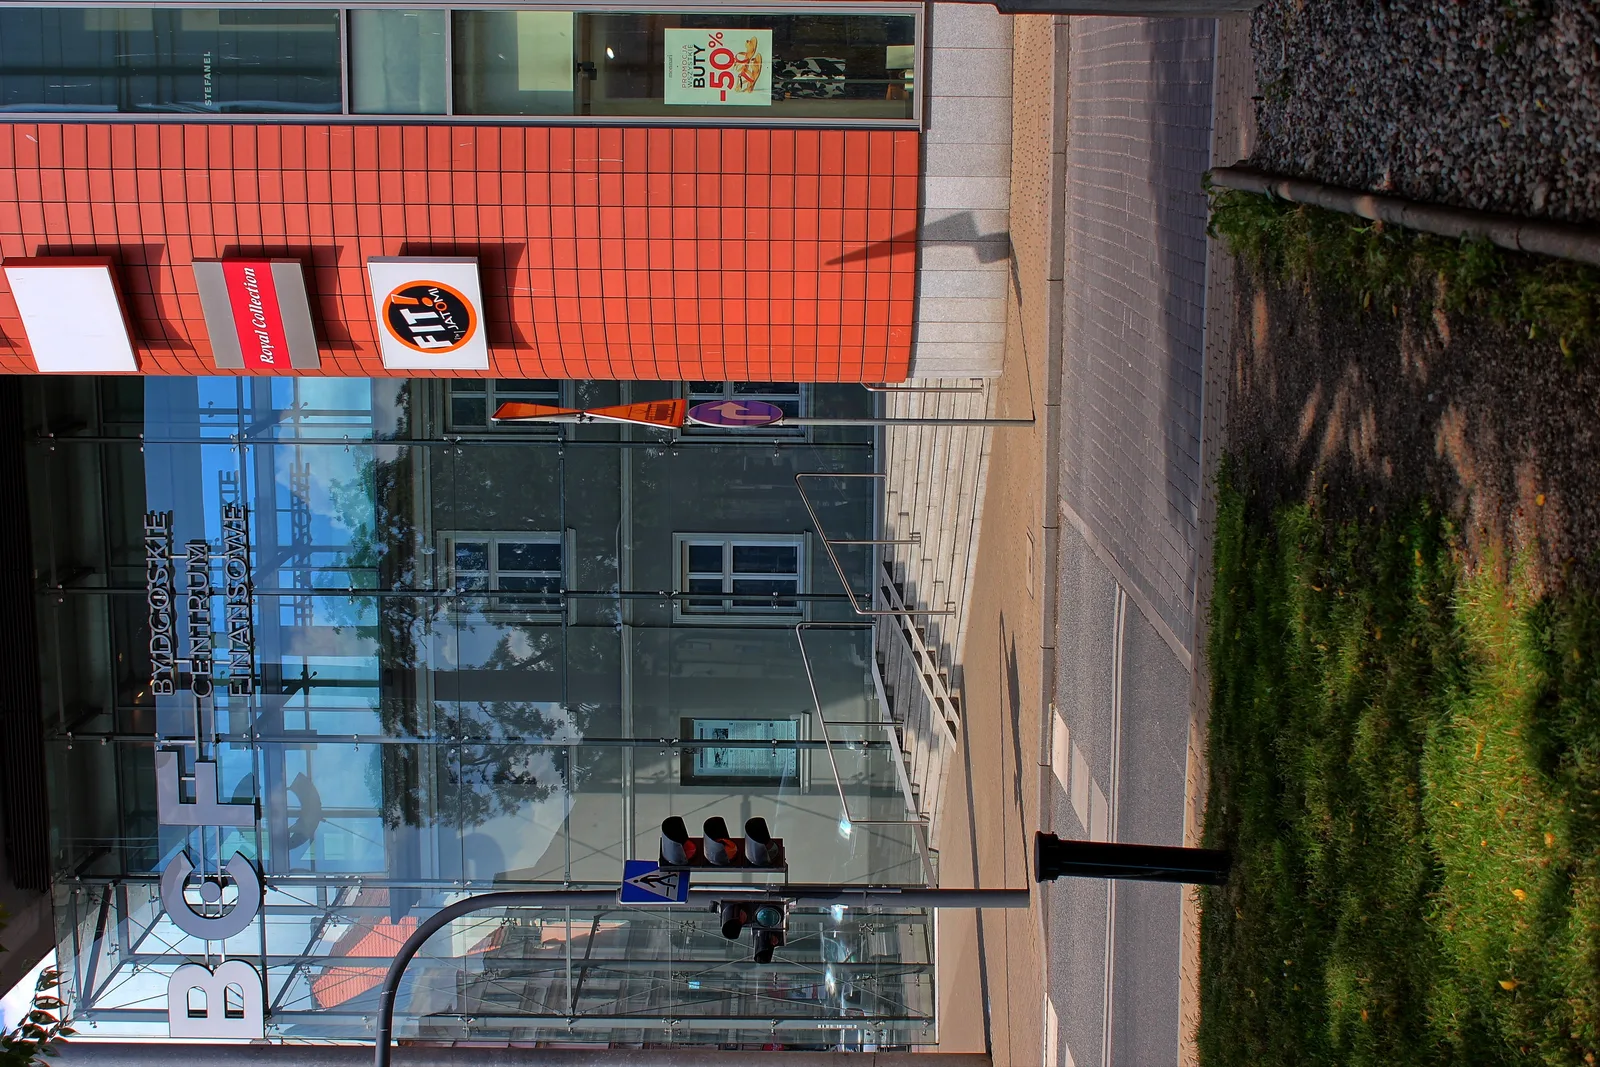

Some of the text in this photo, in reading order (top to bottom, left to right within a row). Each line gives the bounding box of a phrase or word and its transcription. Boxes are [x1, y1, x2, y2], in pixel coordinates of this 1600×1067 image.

[203, 51, 212, 106] STEFANEL
[693, 44, 706, 88] BUTY
[708, 32, 735, 102] -50%
[243, 267, 275, 364] Royal Collection
[391, 294, 454, 349] FIT!
[428, 287, 459, 330] JATOMI
[144, 512, 175, 697] BYDGOSKIE
[184, 542, 214, 699] CENTRUM
[221, 504, 252, 698] FINANSOWE
[155, 751, 265, 1039] BCF
